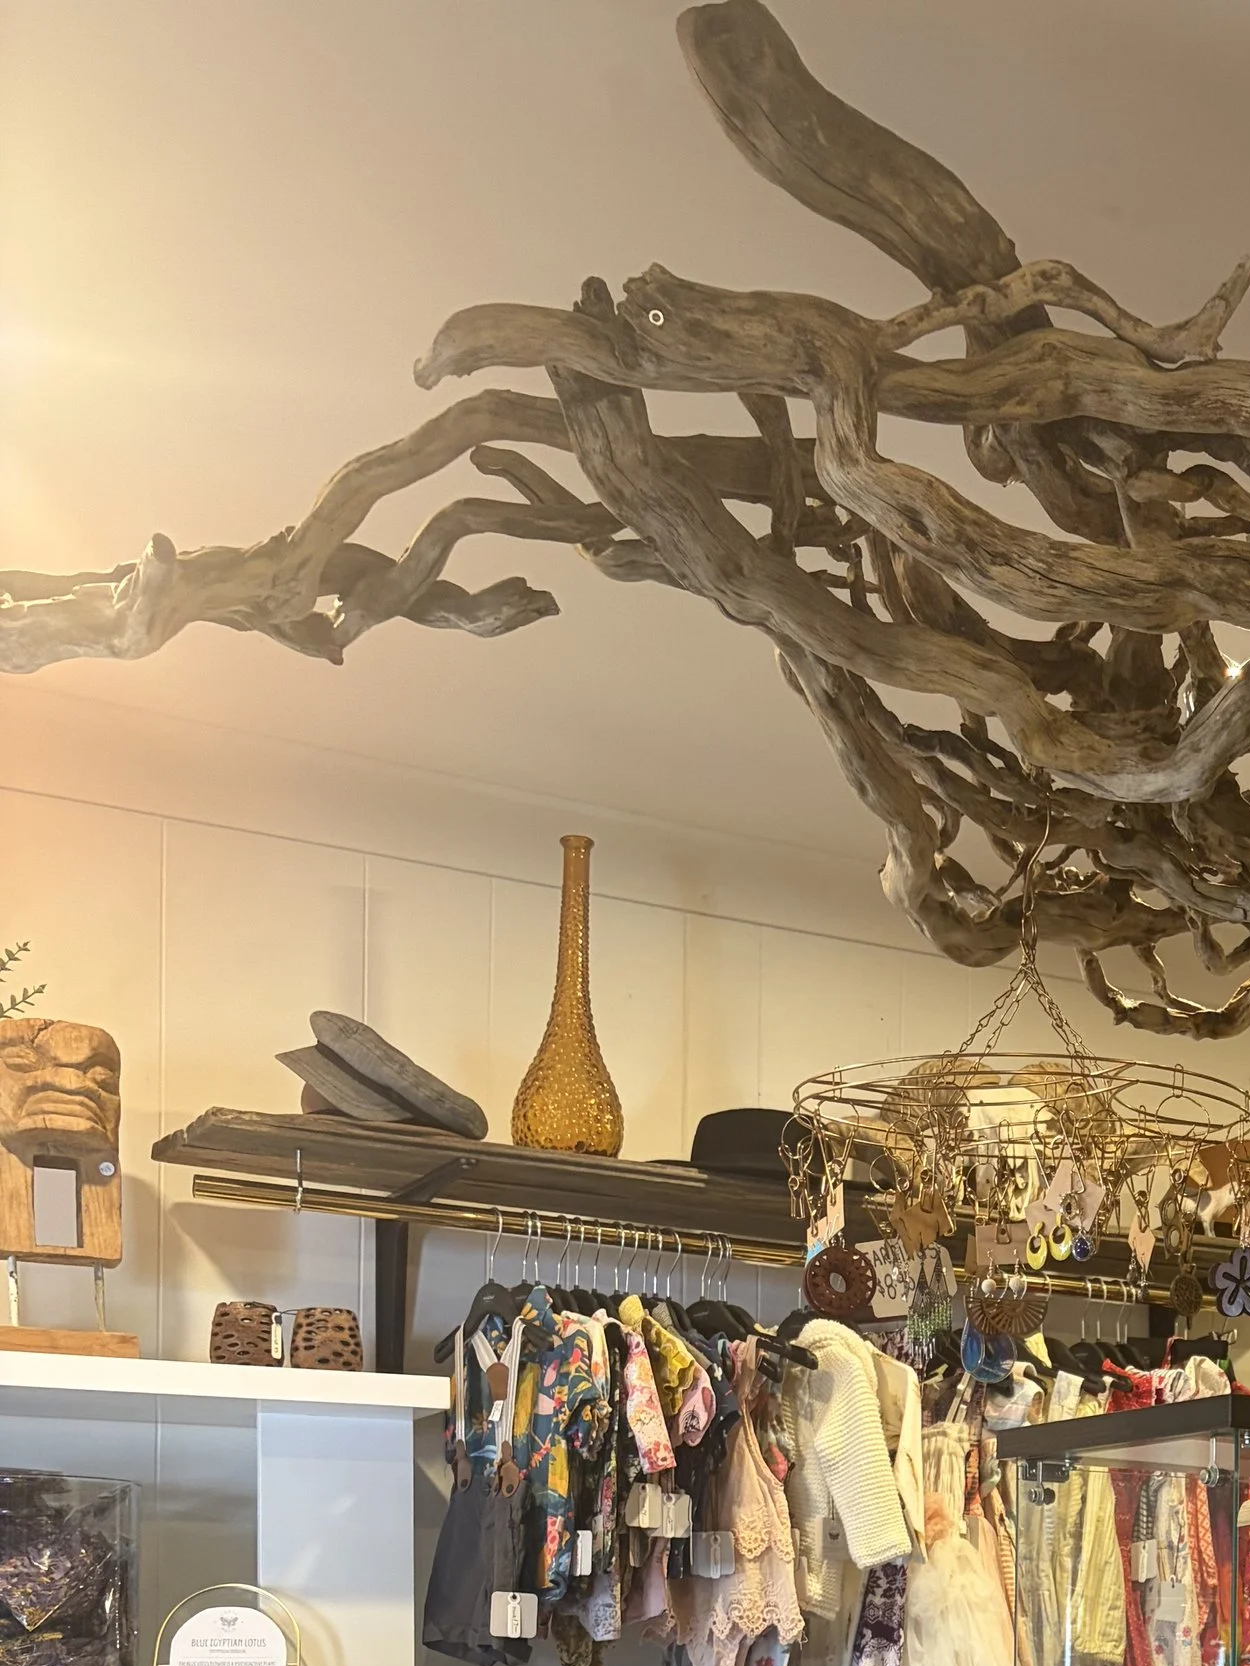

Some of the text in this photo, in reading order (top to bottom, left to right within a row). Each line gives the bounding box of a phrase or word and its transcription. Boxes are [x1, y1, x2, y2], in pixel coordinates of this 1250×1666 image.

[191, 1638, 267, 1648] BLUE EGYPTIAN LOTUS
